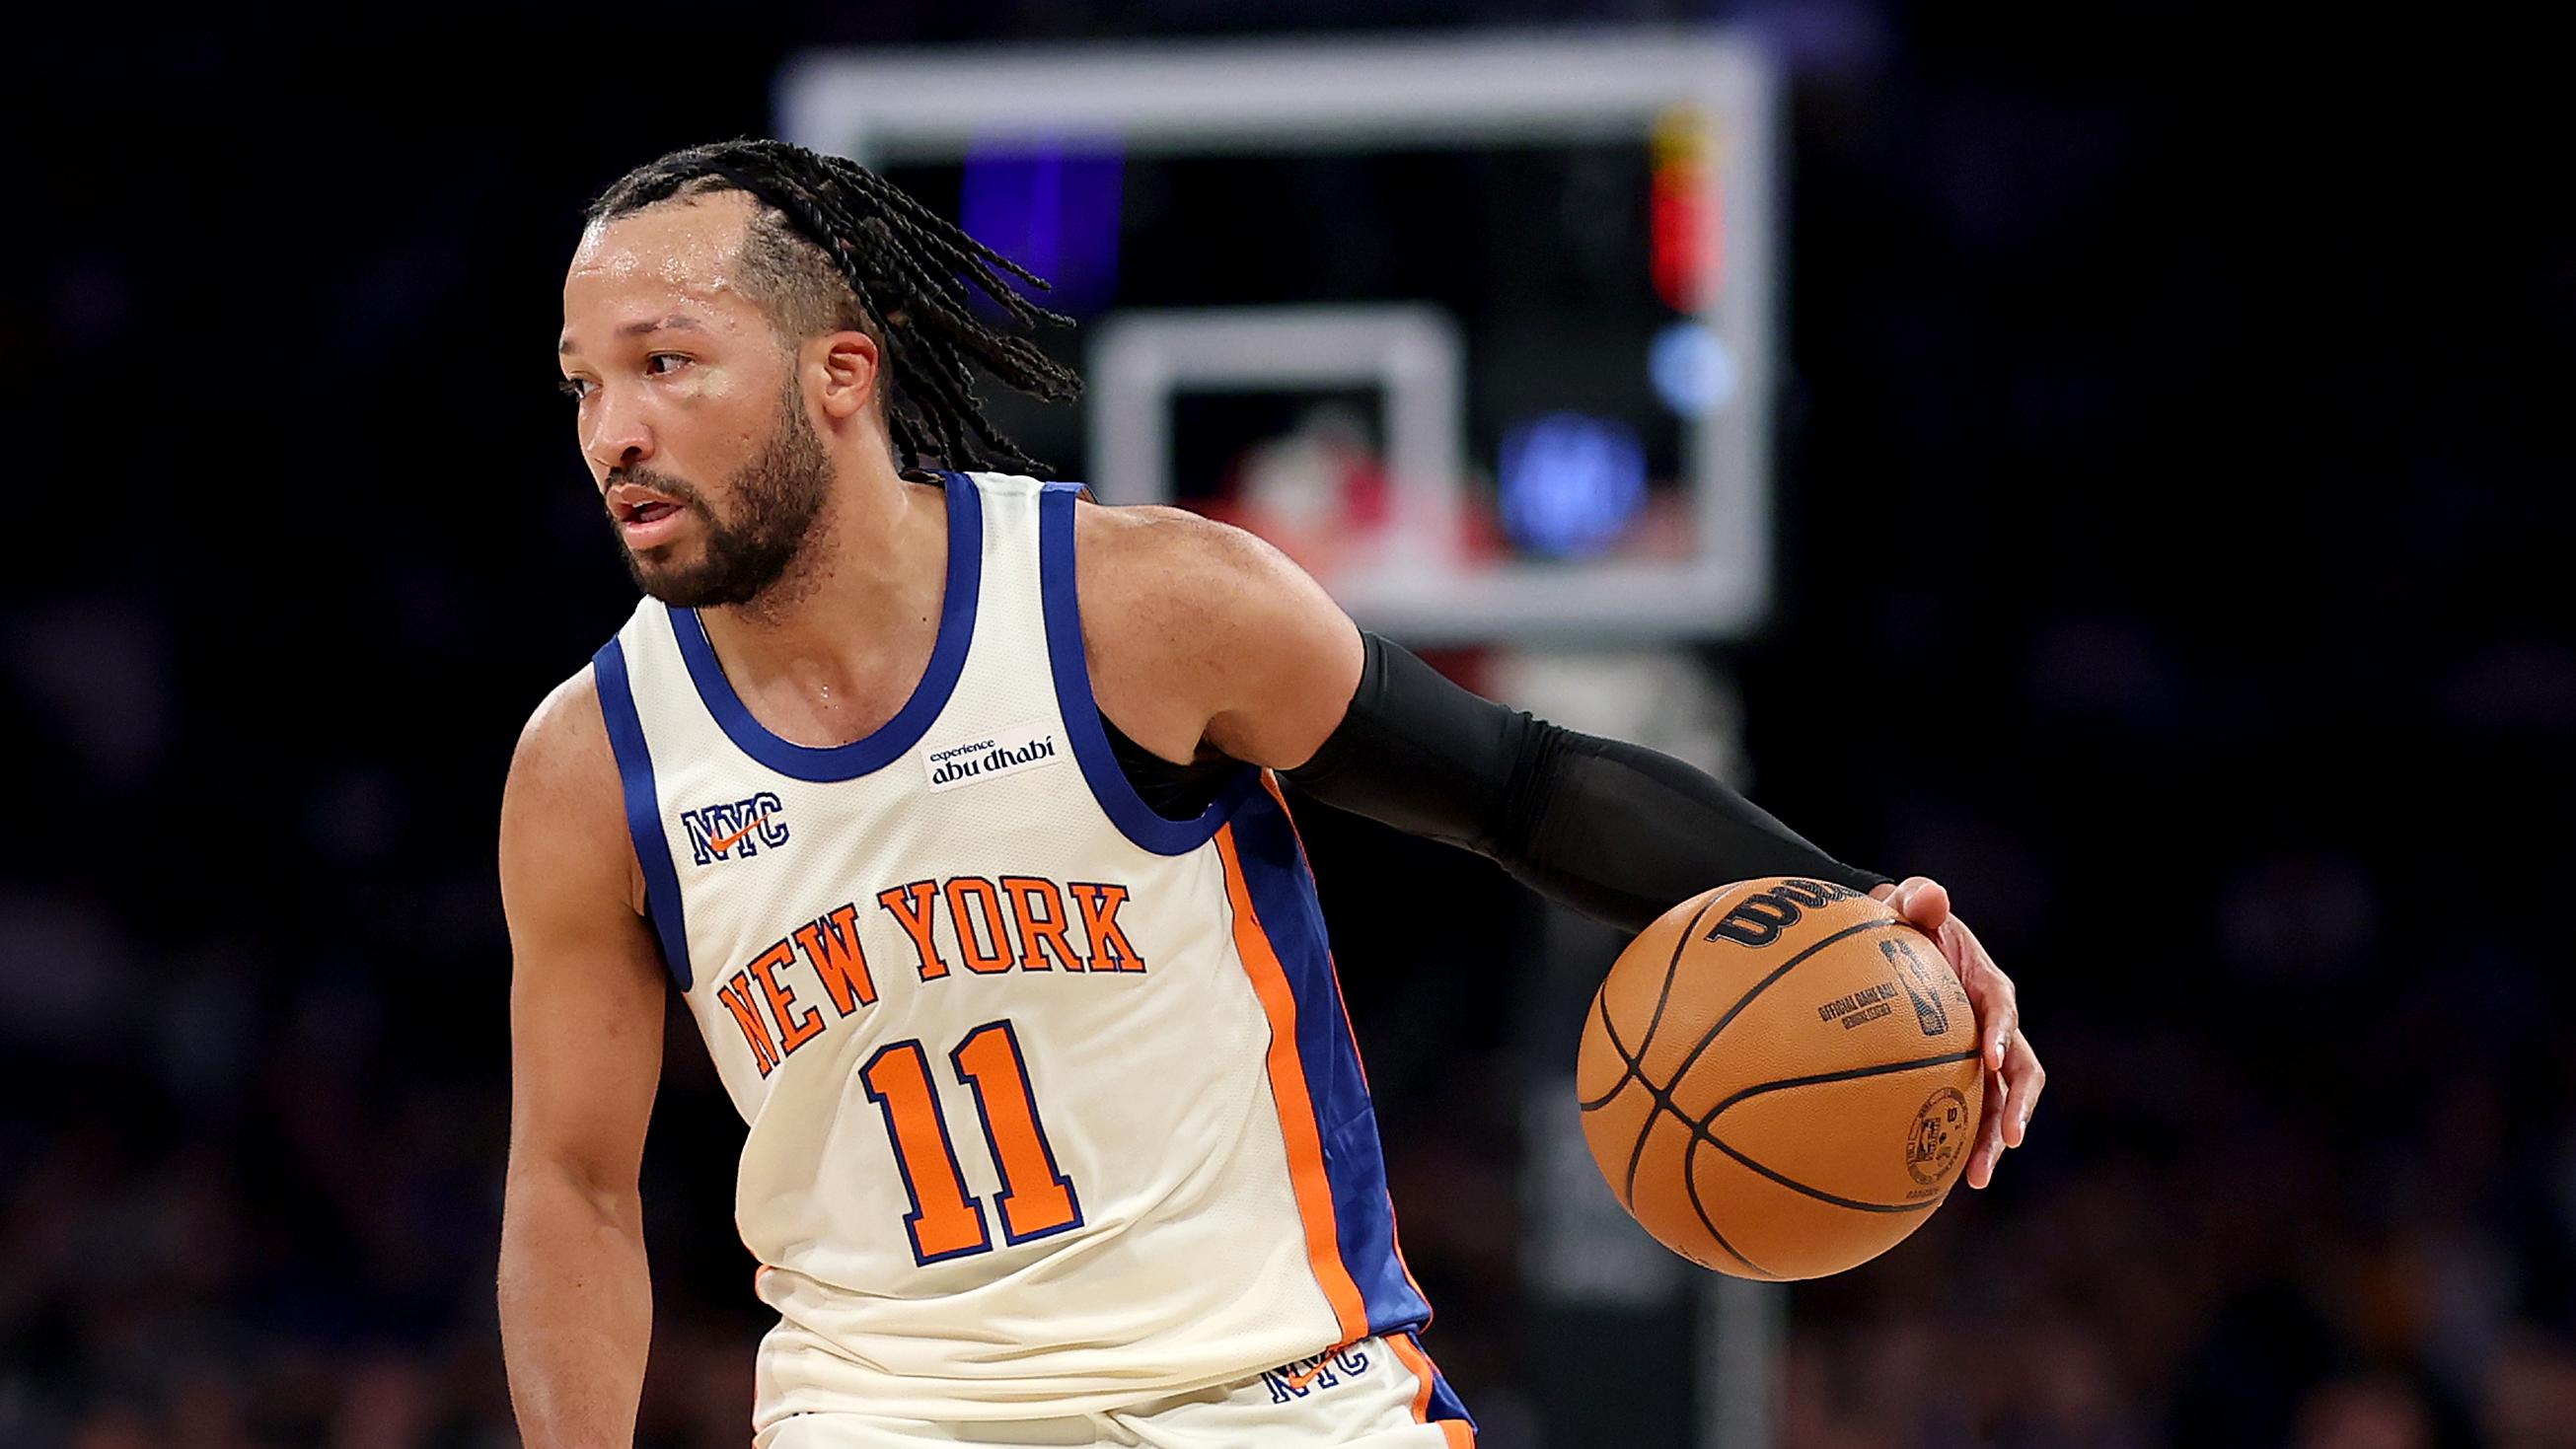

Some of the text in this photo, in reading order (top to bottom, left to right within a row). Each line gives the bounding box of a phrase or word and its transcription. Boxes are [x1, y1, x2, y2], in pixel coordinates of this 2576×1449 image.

[929, 739, 995, 761] experience
[932, 735, 1056, 785] abu dhabi
[680, 791, 790, 866] NYC
[716, 875, 1147, 1080] NEW YORK
[1818, 994, 1859, 1022] OFFICIAL
[857, 1018, 1085, 1268] 11
